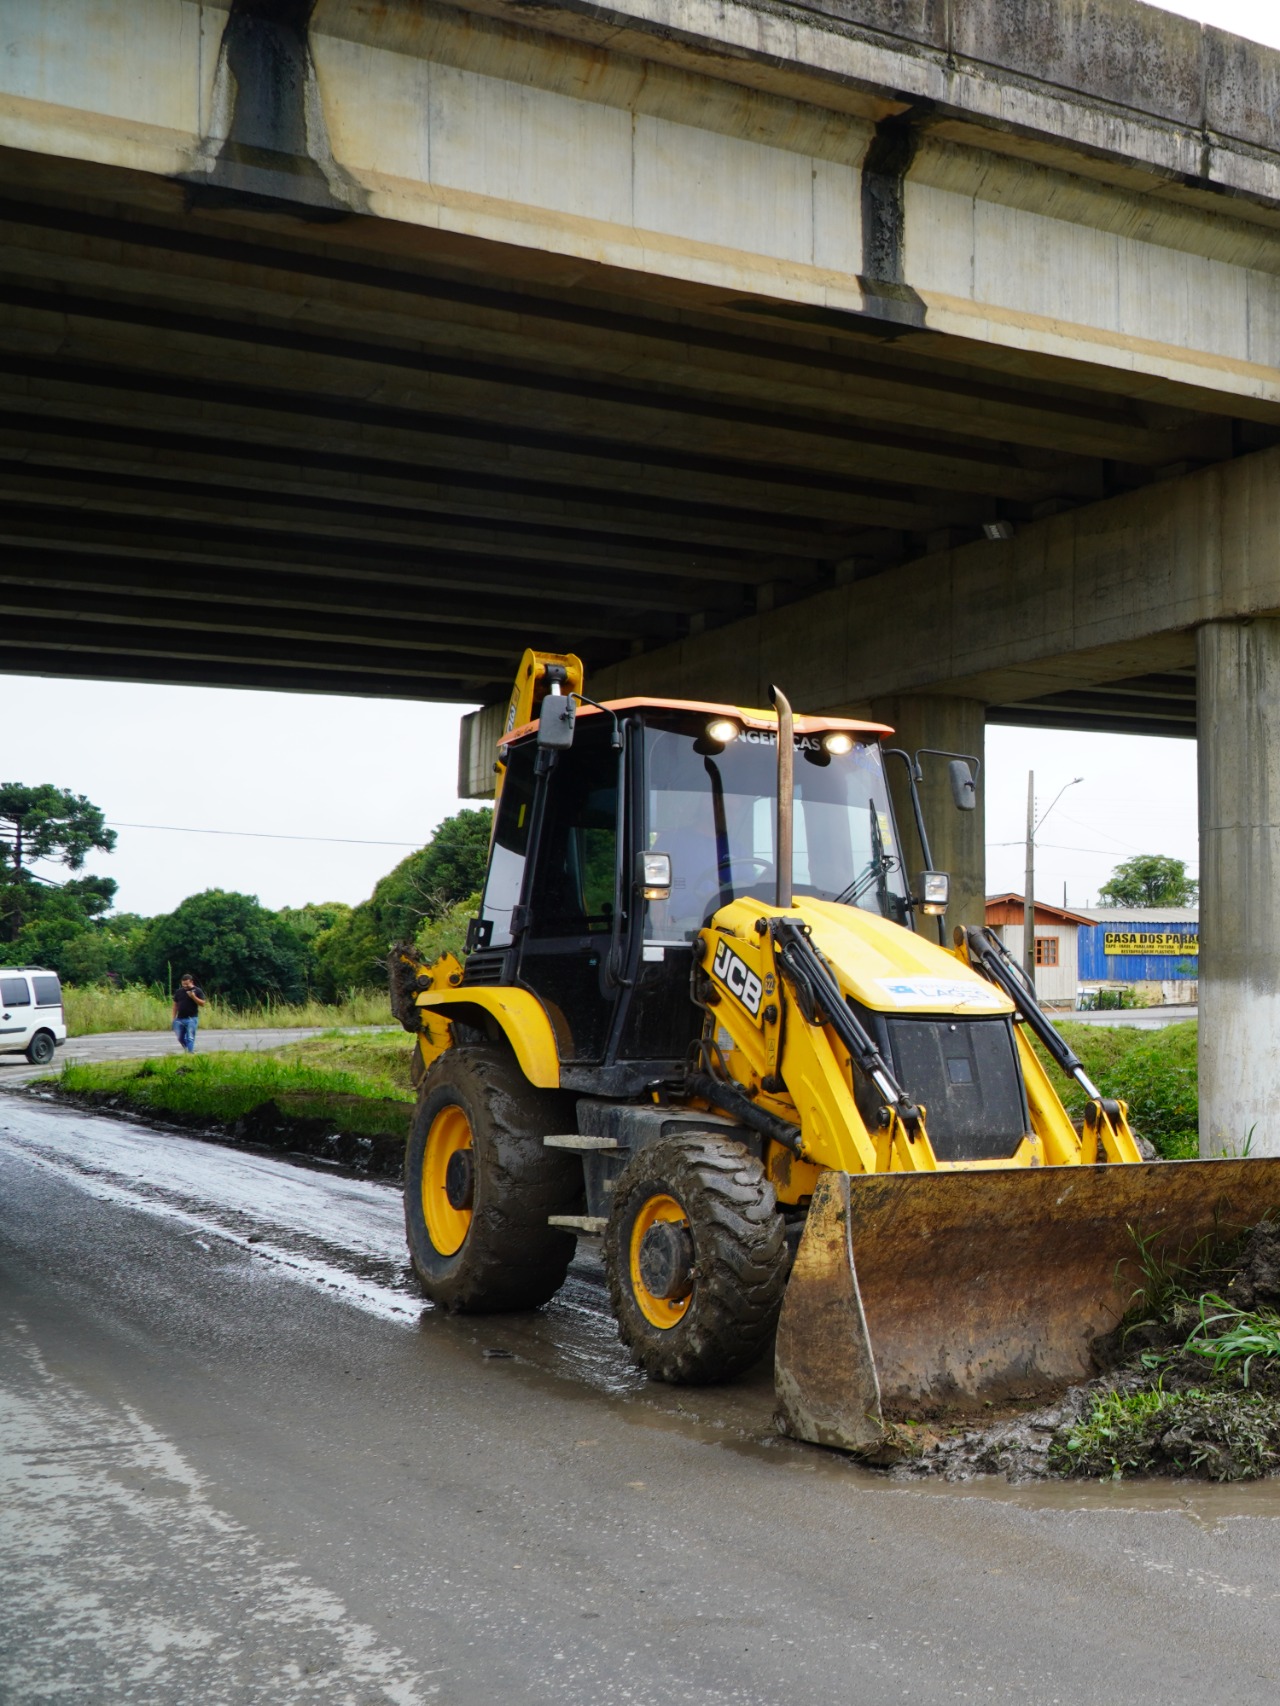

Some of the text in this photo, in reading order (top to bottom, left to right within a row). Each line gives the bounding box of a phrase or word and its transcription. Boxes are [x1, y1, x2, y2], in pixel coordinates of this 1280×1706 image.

[733, 730, 820, 752] NGEPÇAS
[1105, 933, 1137, 944] CASA
[1139, 933, 1164, 944] DOS
[713, 948, 763, 1014] JCB
